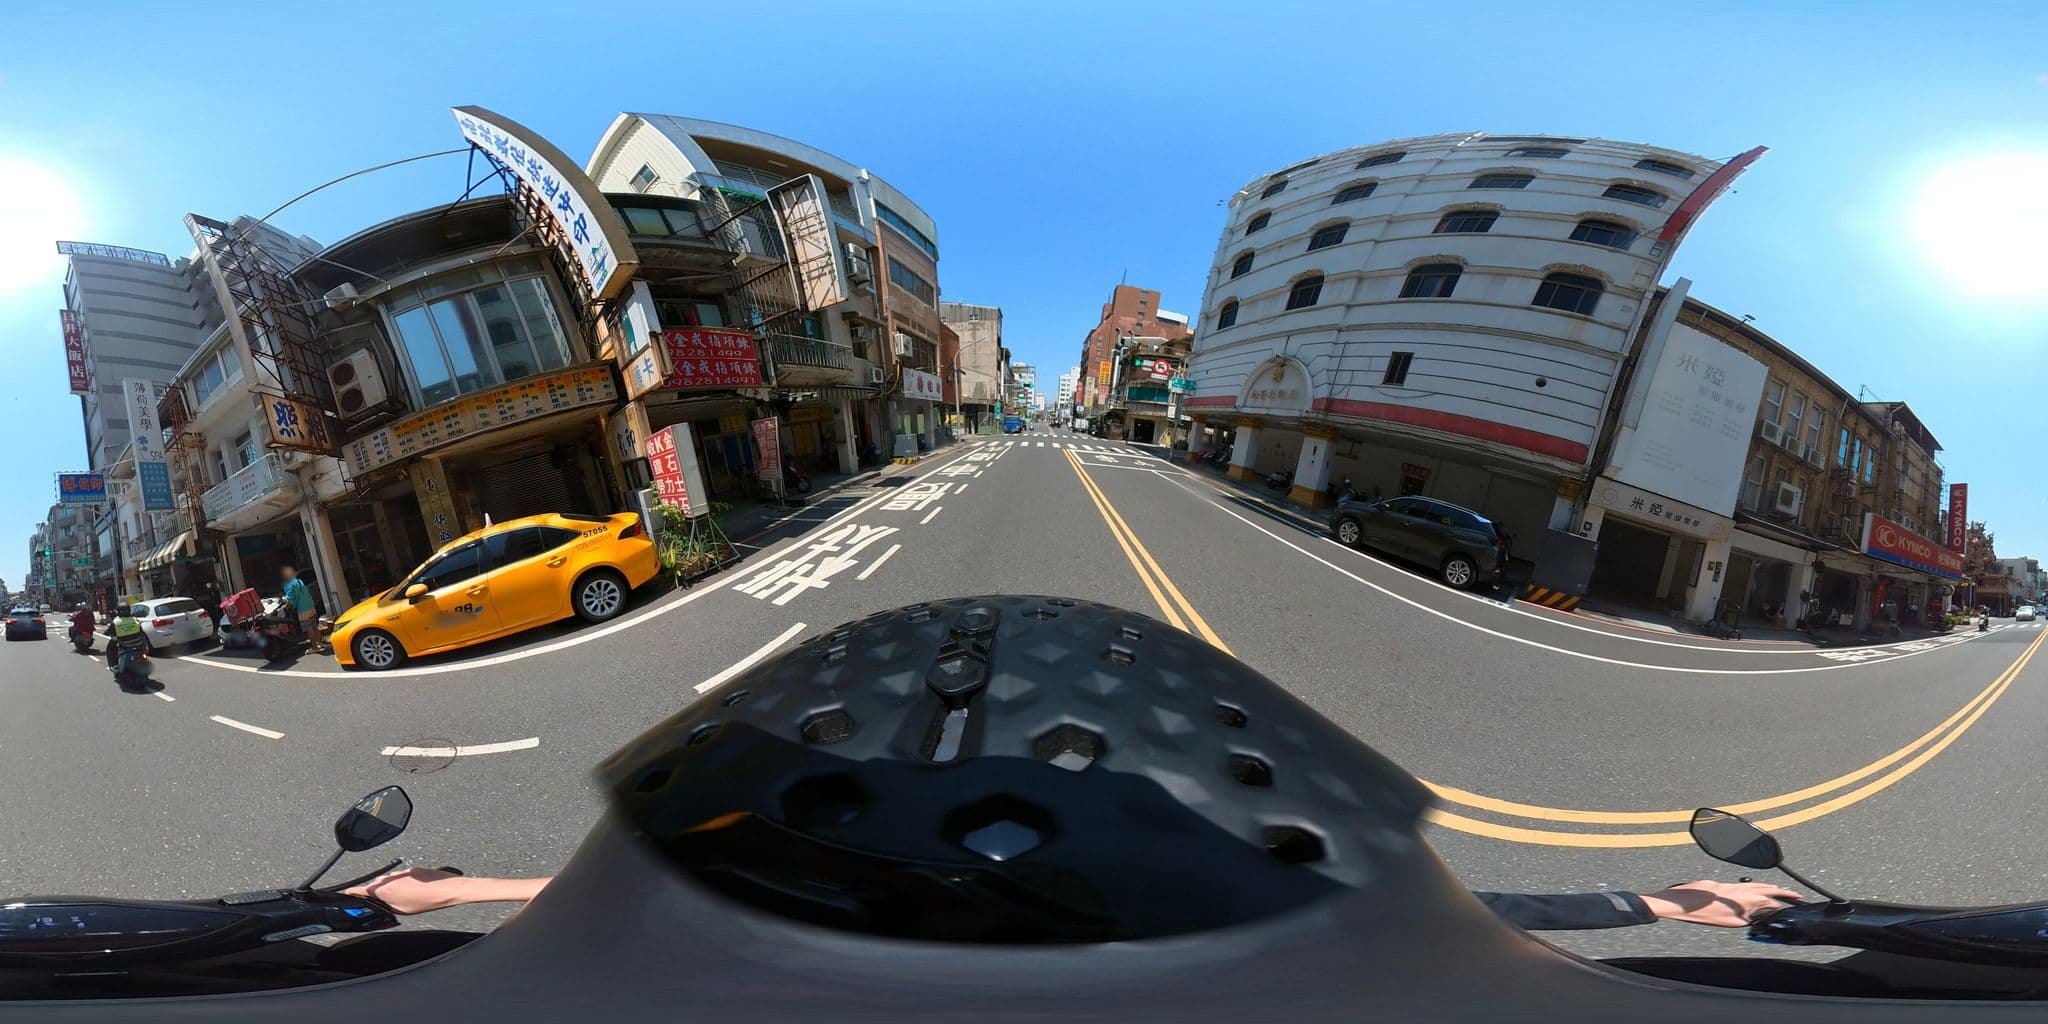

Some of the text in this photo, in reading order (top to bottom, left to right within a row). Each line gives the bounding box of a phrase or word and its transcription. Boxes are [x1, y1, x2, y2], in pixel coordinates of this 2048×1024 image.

[646, 431, 674, 456] 收K金
[652, 454, 678, 475] 鑽石
[657, 475, 685, 495] 勞力士
[582, 525, 608, 538] 57055
[1954, 500, 1963, 547] KYMCO
[1898, 535, 1931, 559] KYMCO
